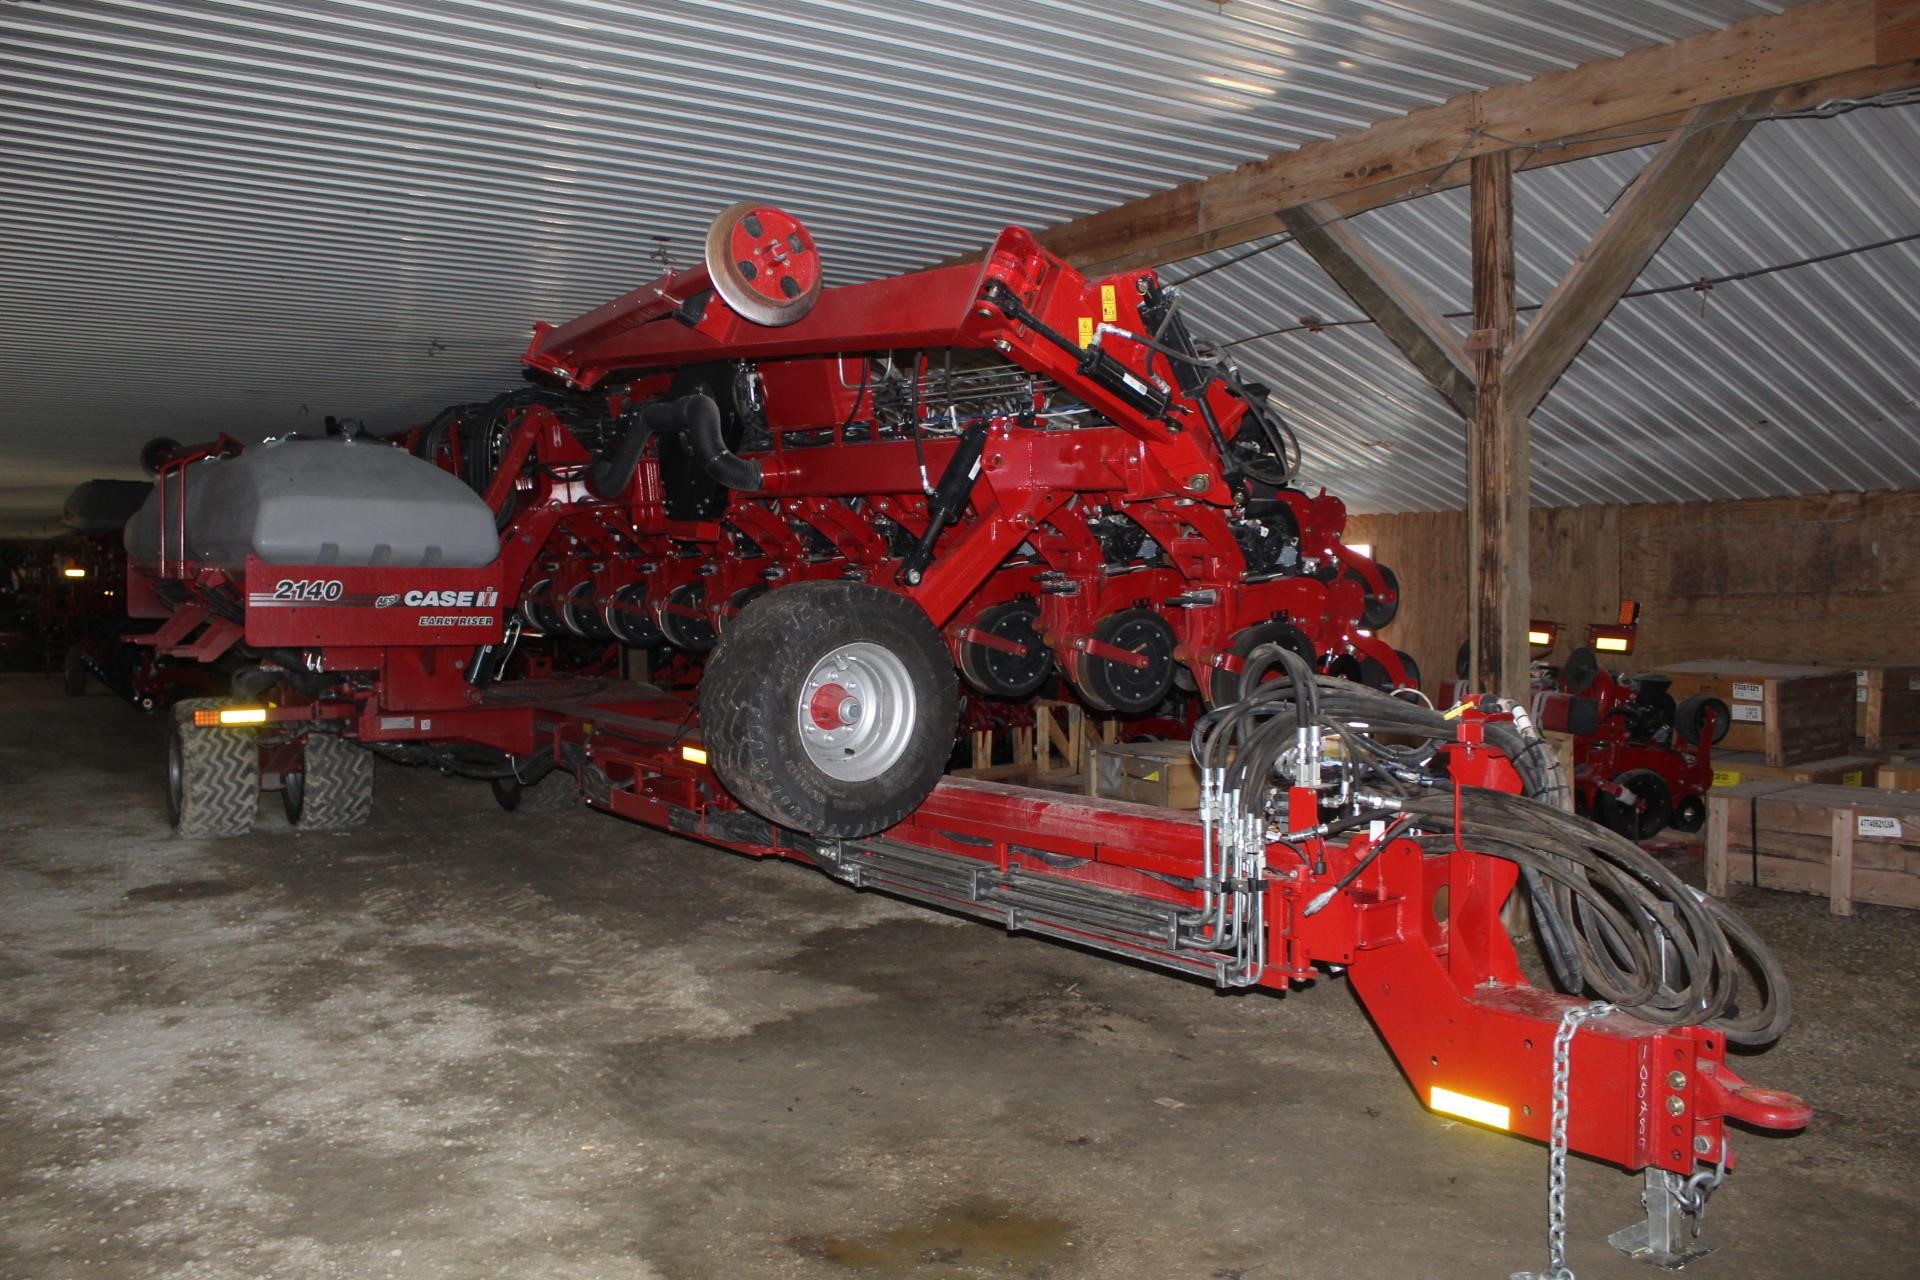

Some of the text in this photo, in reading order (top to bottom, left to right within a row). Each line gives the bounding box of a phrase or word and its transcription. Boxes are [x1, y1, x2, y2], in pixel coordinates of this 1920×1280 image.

[273, 579, 344, 601] 2140
[404, 590, 474, 607] CASE
[419, 616, 494, 626] EARLY RISER
